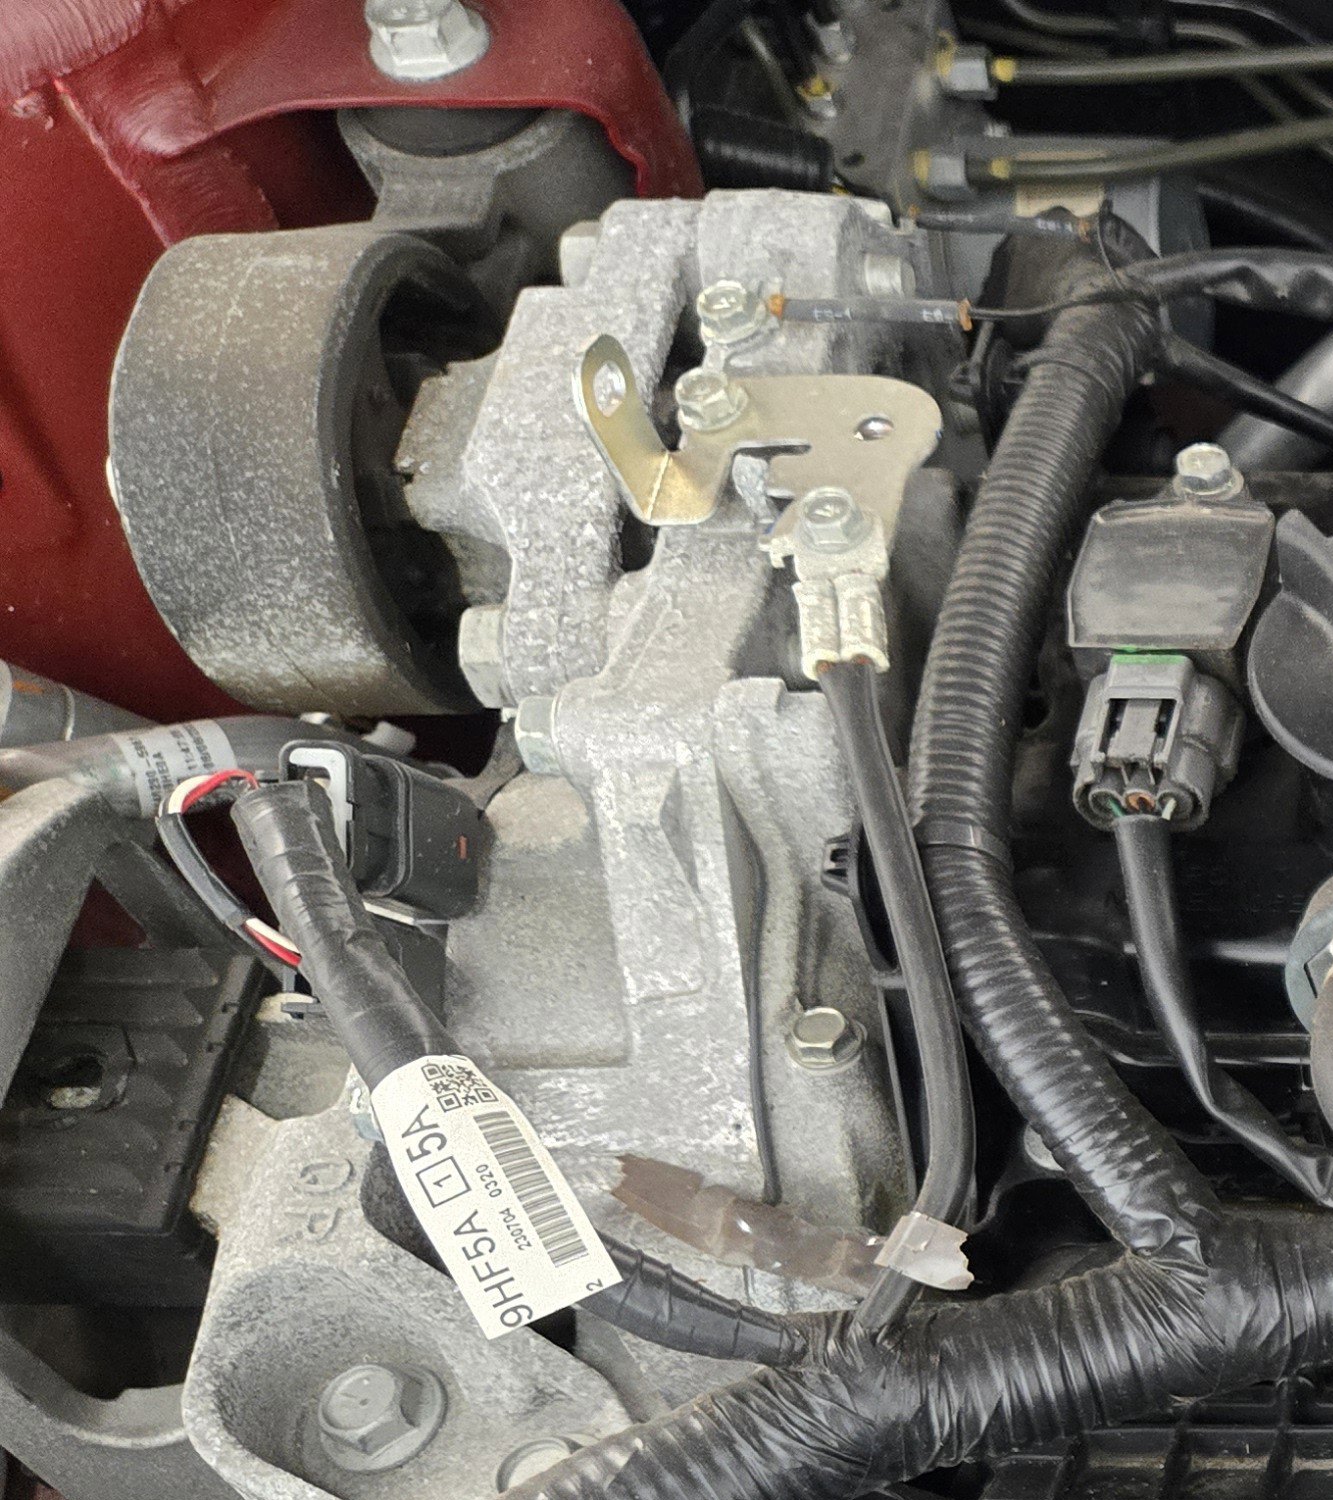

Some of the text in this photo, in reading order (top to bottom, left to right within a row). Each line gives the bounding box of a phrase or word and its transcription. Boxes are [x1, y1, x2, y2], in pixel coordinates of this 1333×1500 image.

[402, 1105, 448, 1162] 5A
[476, 1164, 532, 1251] 230704 0320
[454, 1210, 533, 1328] 9HF5A
[586, 1278, 604, 1292] 2
